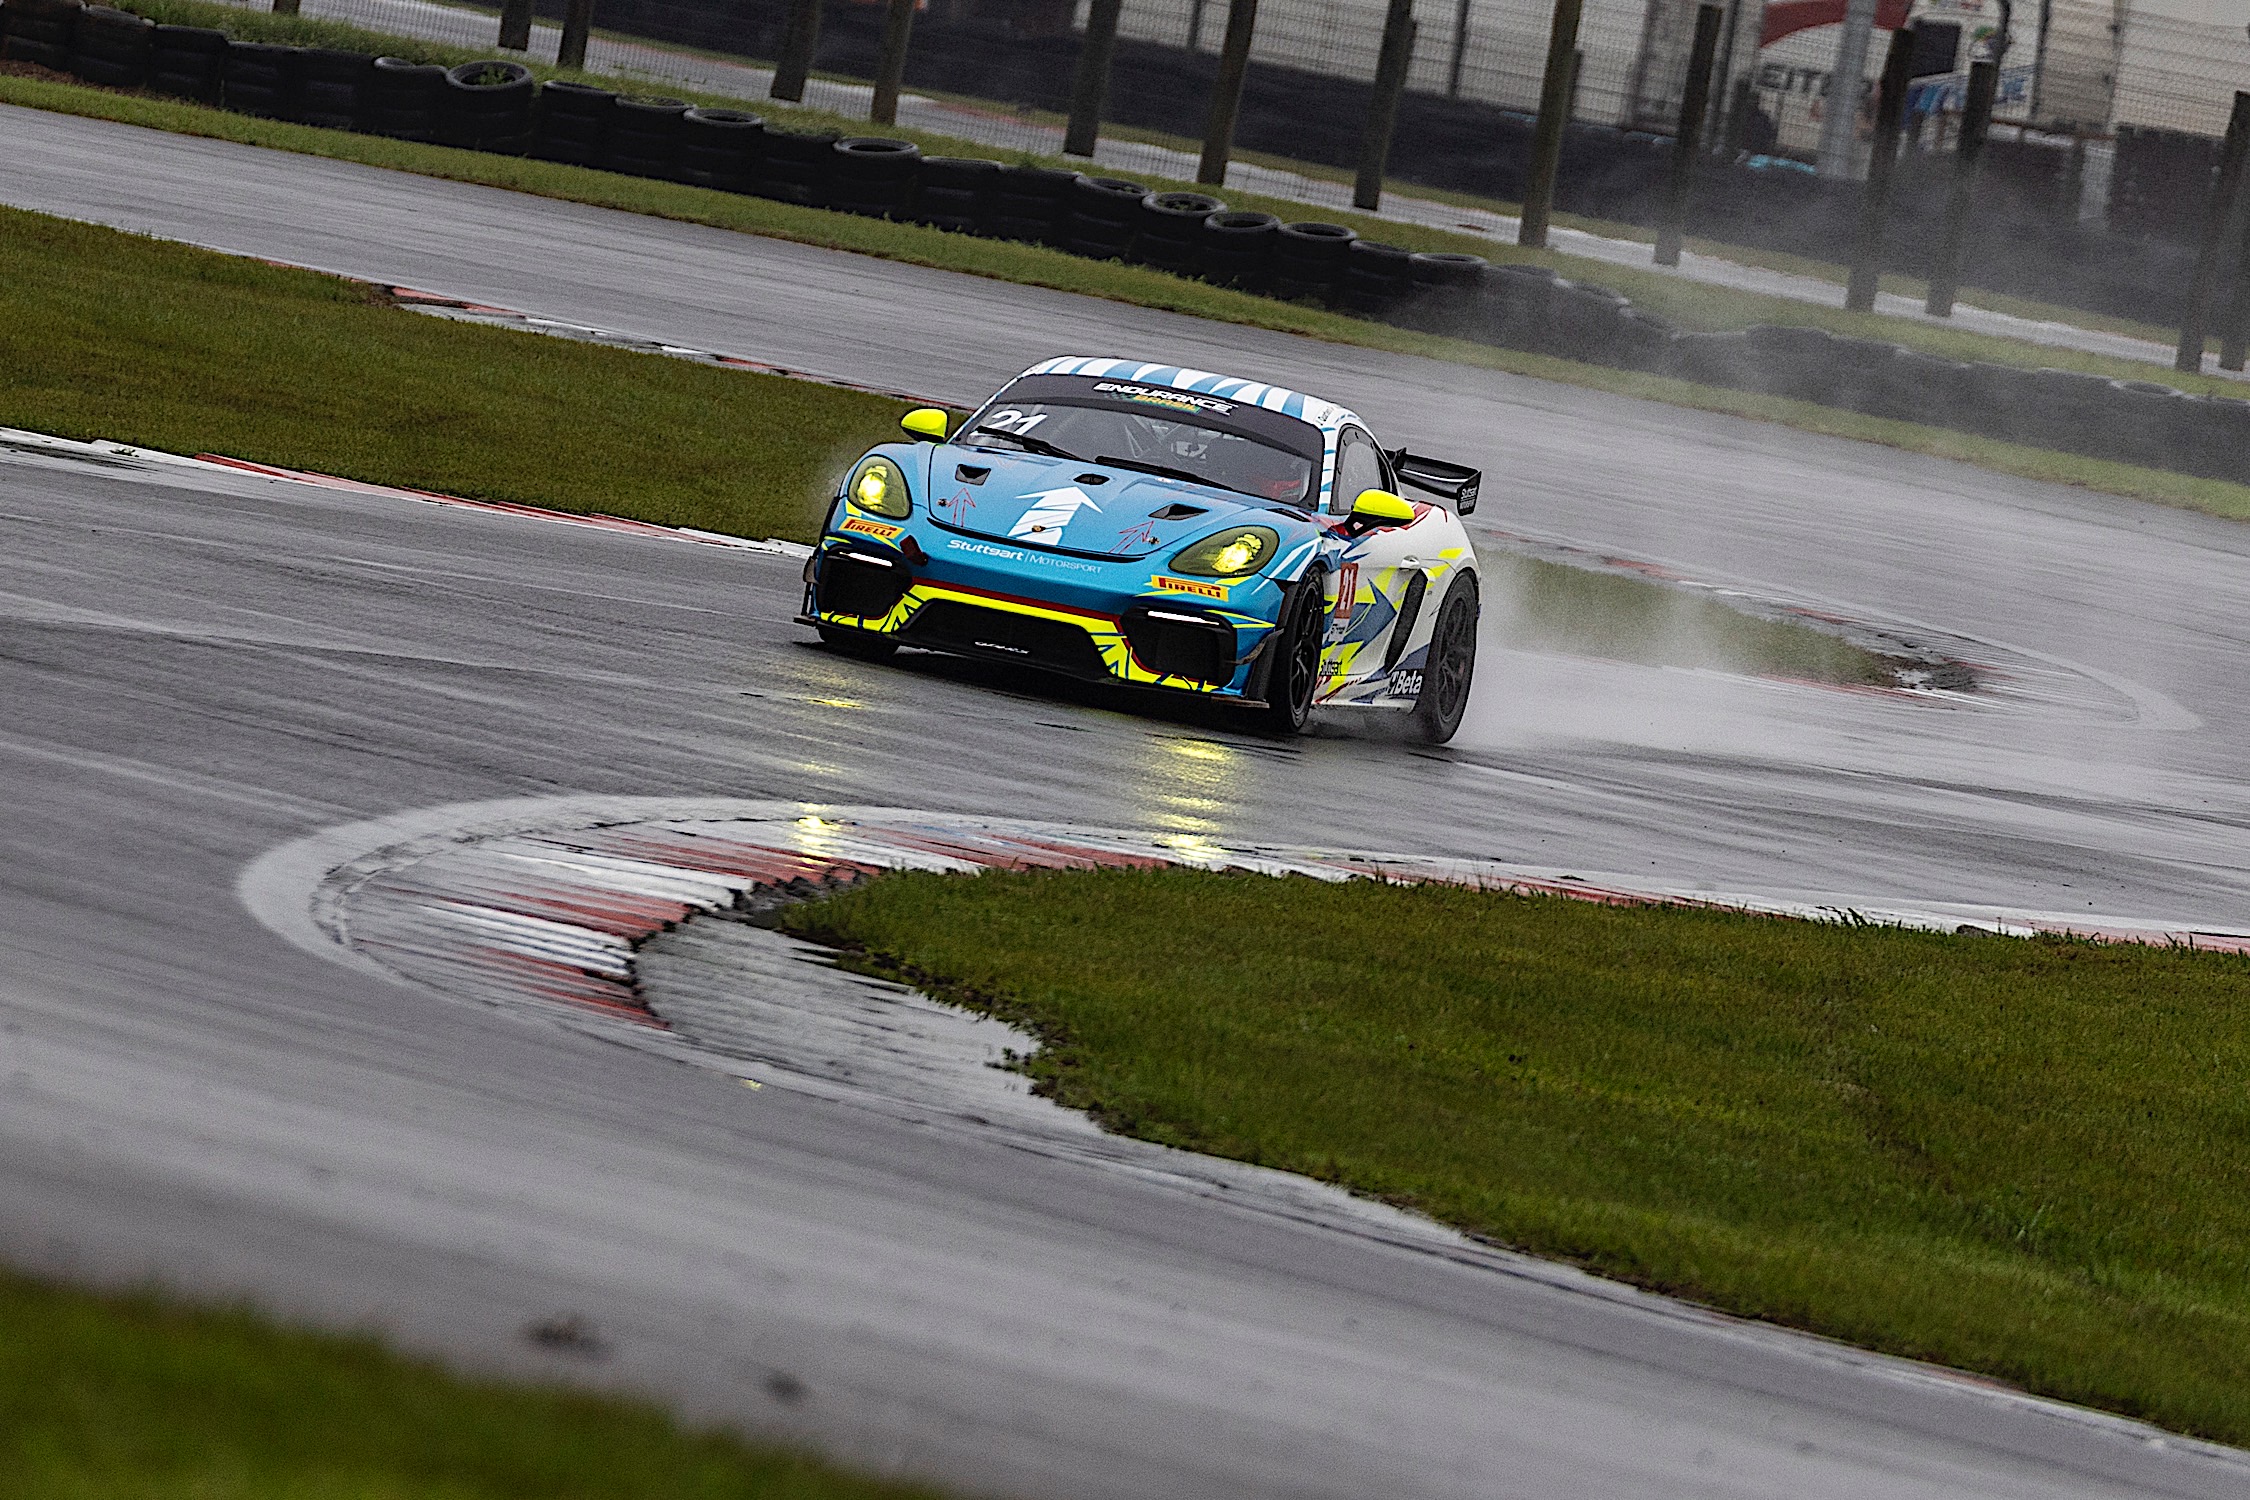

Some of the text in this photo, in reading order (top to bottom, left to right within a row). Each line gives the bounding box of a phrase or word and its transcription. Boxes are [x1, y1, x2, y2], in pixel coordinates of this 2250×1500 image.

[1093, 382, 1233, 416] ENDURANCE
[985, 410, 1048, 435] 21
[843, 519, 897, 537] PIRELLI
[947, 540, 1023, 561] Stuttgart
[1158, 577, 1221, 598] PIRELLI
[1340, 568, 1355, 611] 21
